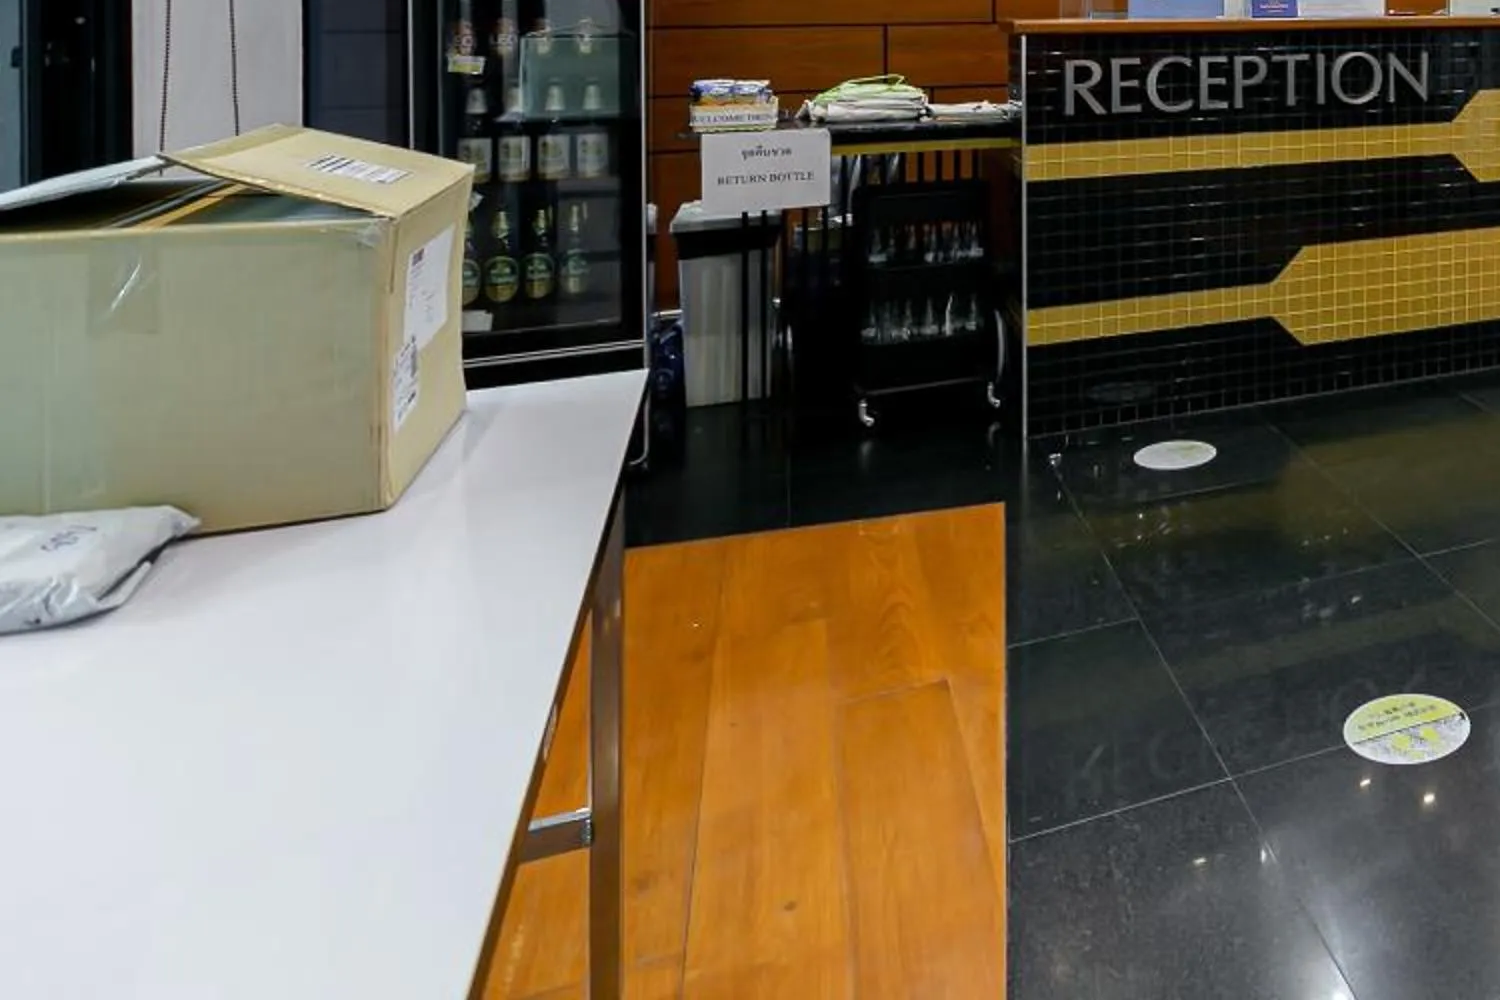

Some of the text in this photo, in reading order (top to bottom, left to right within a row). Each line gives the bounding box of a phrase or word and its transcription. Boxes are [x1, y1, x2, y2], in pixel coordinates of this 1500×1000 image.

[1064, 50, 1429, 115] RECEPTION
[717, 170, 816, 186] RETURN BOTTLE
